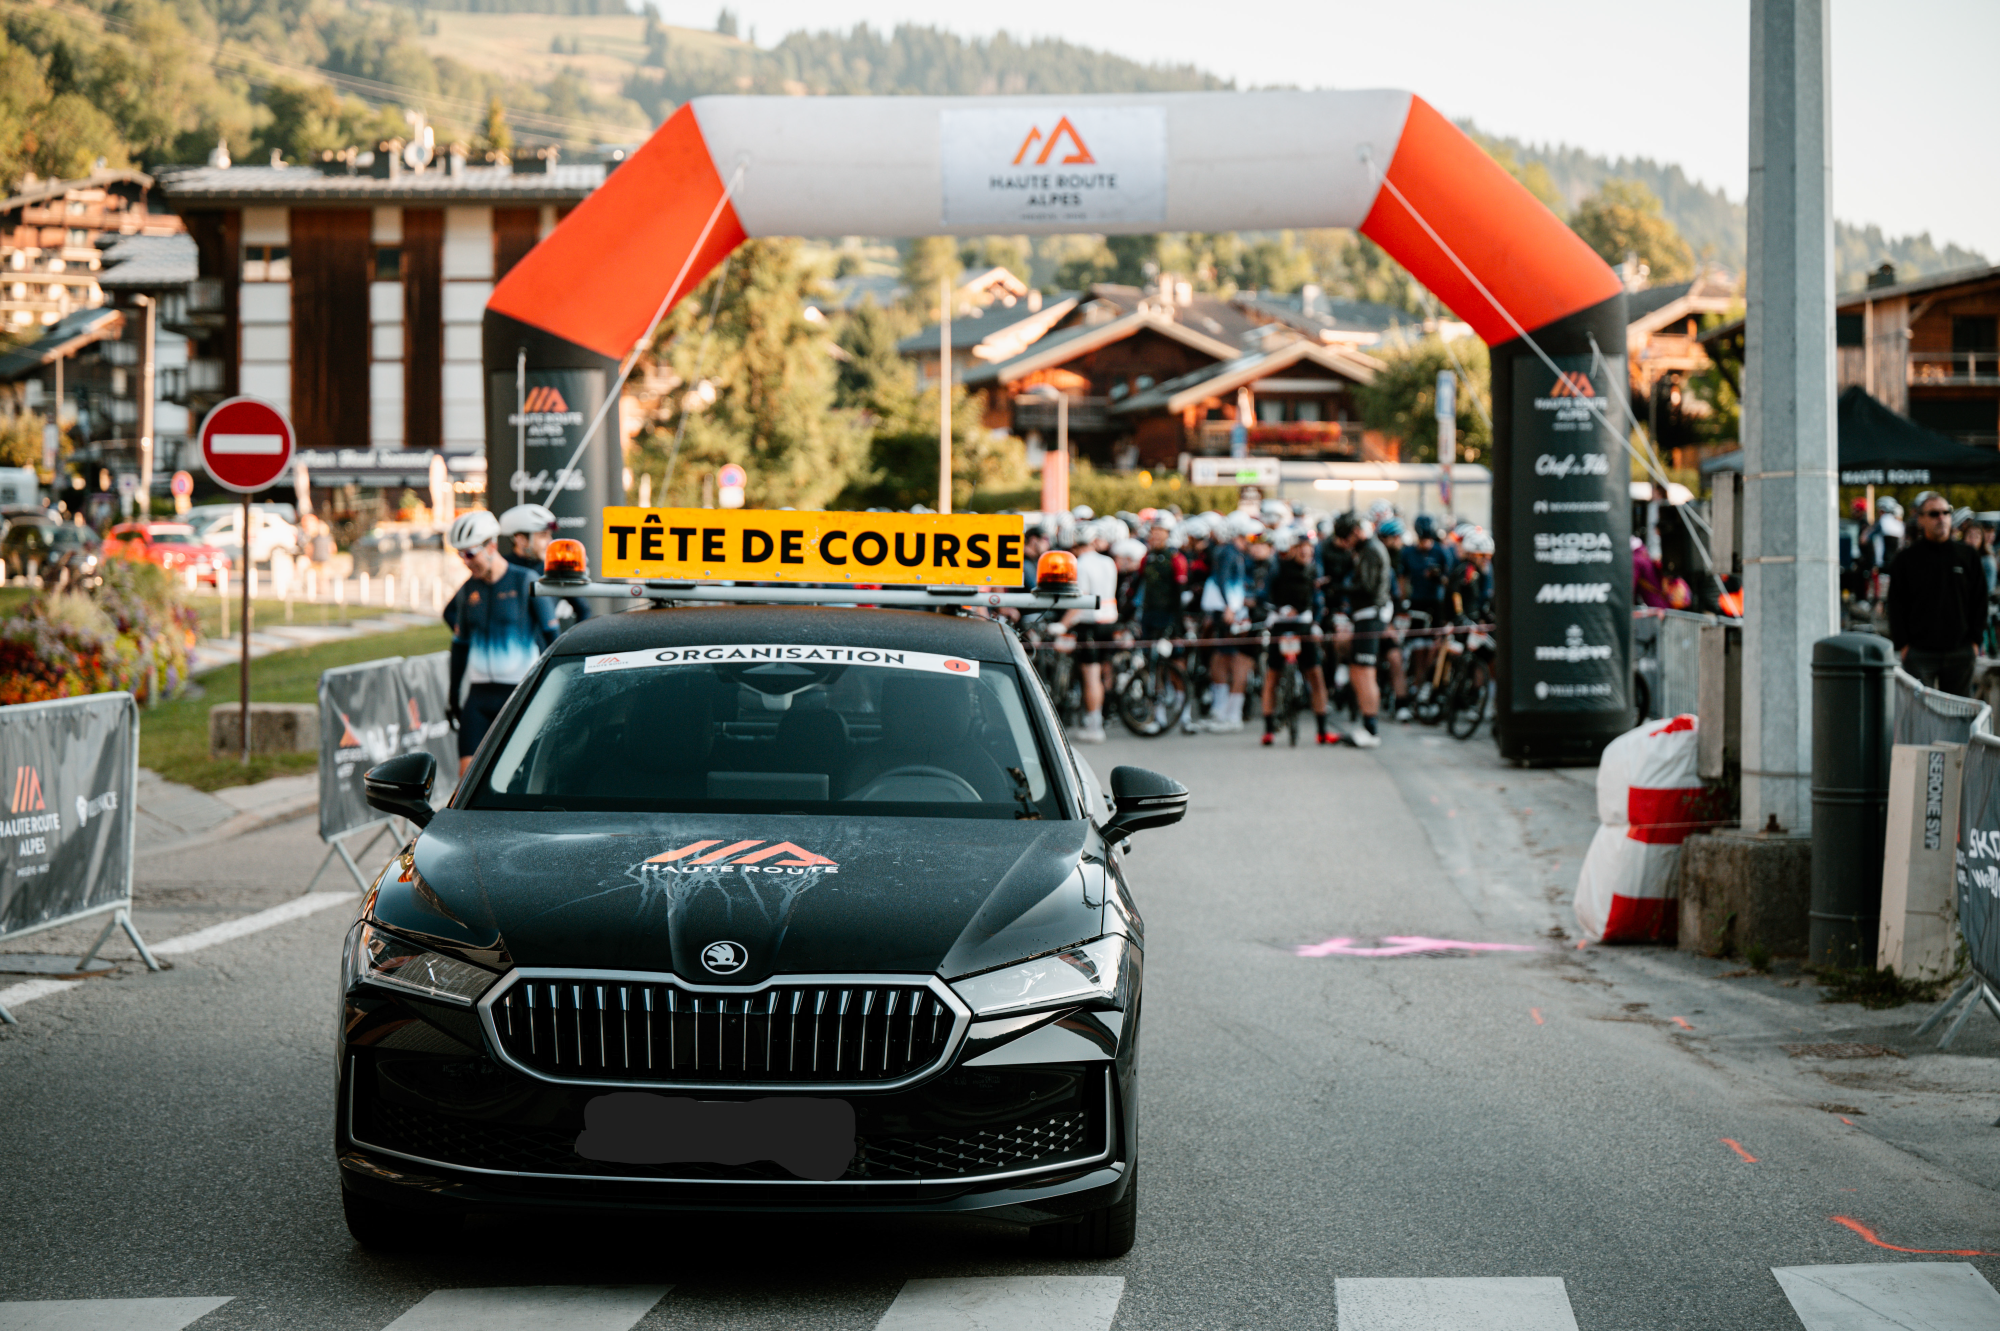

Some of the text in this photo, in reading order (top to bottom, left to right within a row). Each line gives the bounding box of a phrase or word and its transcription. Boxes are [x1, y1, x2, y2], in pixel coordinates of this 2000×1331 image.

[990, 173, 1117, 190] HAUTE ROUTE
[1027, 192, 1082, 206] ALPES
[1886, 469, 1930, 485] ROUTE
[608, 514, 1021, 570] TÊTE DE COURSE
[655, 647, 905, 665] ORGANISATION
[19, 837, 46, 857] ALPES
[641, 864, 839, 875] HAUTE ROUTE
